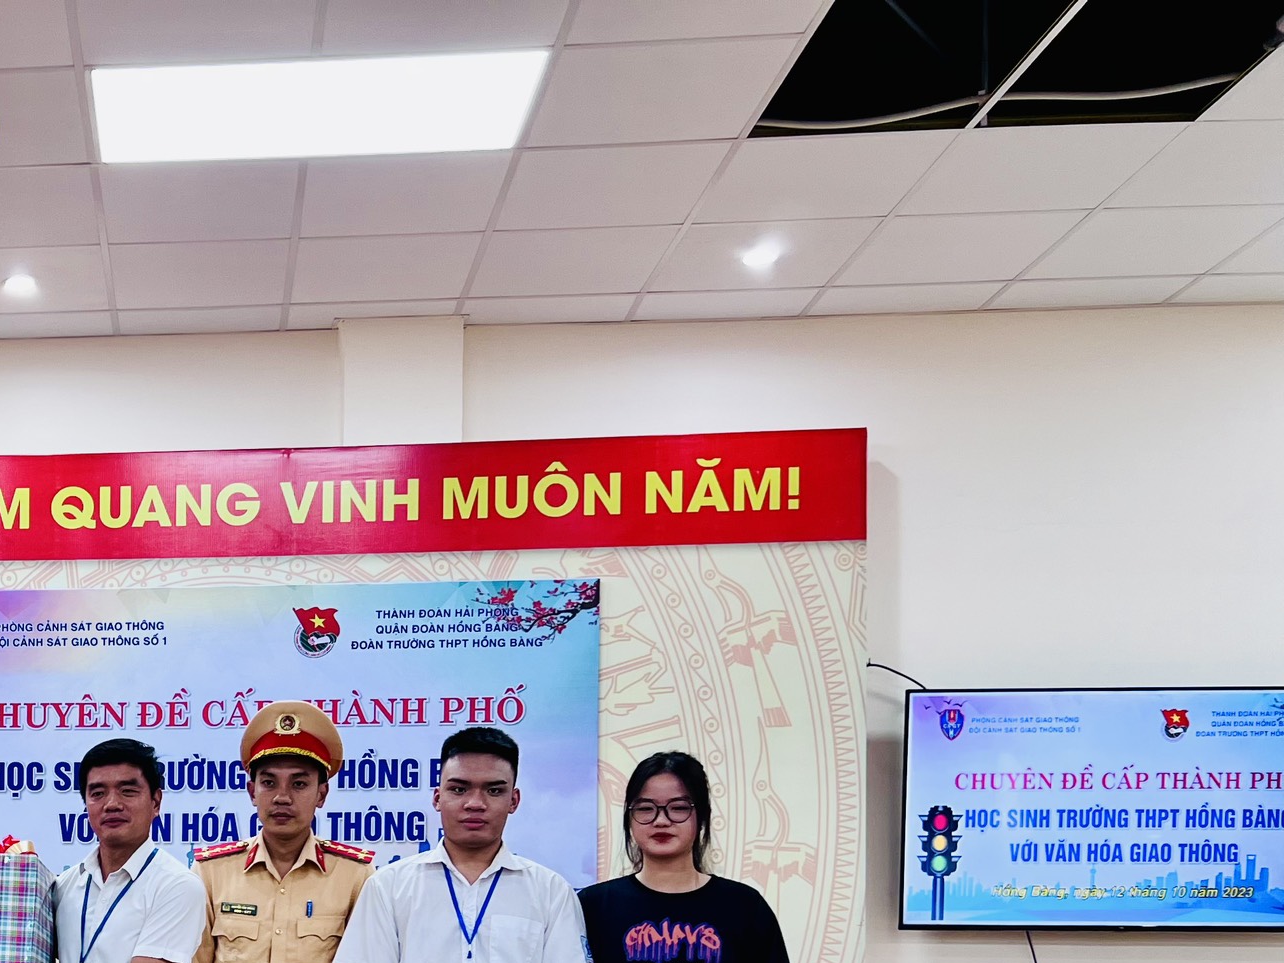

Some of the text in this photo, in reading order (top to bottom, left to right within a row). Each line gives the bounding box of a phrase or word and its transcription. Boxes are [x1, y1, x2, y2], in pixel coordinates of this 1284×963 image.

[50, 481, 261, 529] QUANG
[281, 478, 419, 524] VINH
[443, 461, 622, 520] MUÔN
[646, 457, 801, 514] NĂM!
[375, 607, 415, 619] THÀNH
[418, 606, 451, 618] ĐOÀN
[454, 605, 474, 617] HẢI
[36, 619, 68, 632] CẢNH
[70, 620, 92, 632] SÁT
[95, 622, 123, 632] GIAO
[125, 619, 165, 631] THÔNG
[375, 622, 408, 635] QUẬN
[411, 622, 444, 634] ĐOÀN
[12, 634, 43, 647] CẢNH
[46, 636, 68, 647] SÁT
[71, 637, 98, 647] GIAO
[101, 634, 140, 646] THÔNG
[143, 633, 159, 646] SỐ
[162, 636, 167, 645] 1
[351, 638, 383, 650] ĐOÀN
[386, 637, 435, 649] TRƯỜNG
[439, 639, 469, 648] THPT
[137, 687, 191, 728] ĐỀ
[301, 689, 426, 726] HÀNH
[440, 683, 526, 725] PHỐ
[337, 748, 419, 789] HỒNG
[954, 767, 1055, 791] CHUYÊN
[1061, 764, 1094, 790] ĐỀ
[1101, 764, 1149, 790] CẤP
[1156, 766, 1242, 790] THÀNH
[182, 806, 239, 842] HÓA
[327, 805, 425, 841] THÔNG
[965, 802, 1284, 833] HỌC SINH TRƯỜNG THPT HỒNG BÀN
[1009, 838, 1239, 863] VỚI VĂN HÓA GIAO THÔNG
[1110, 886, 1125, 897] 12
[1172, 886, 1186, 898] 10
[1222, 886, 1255, 898] 2023
